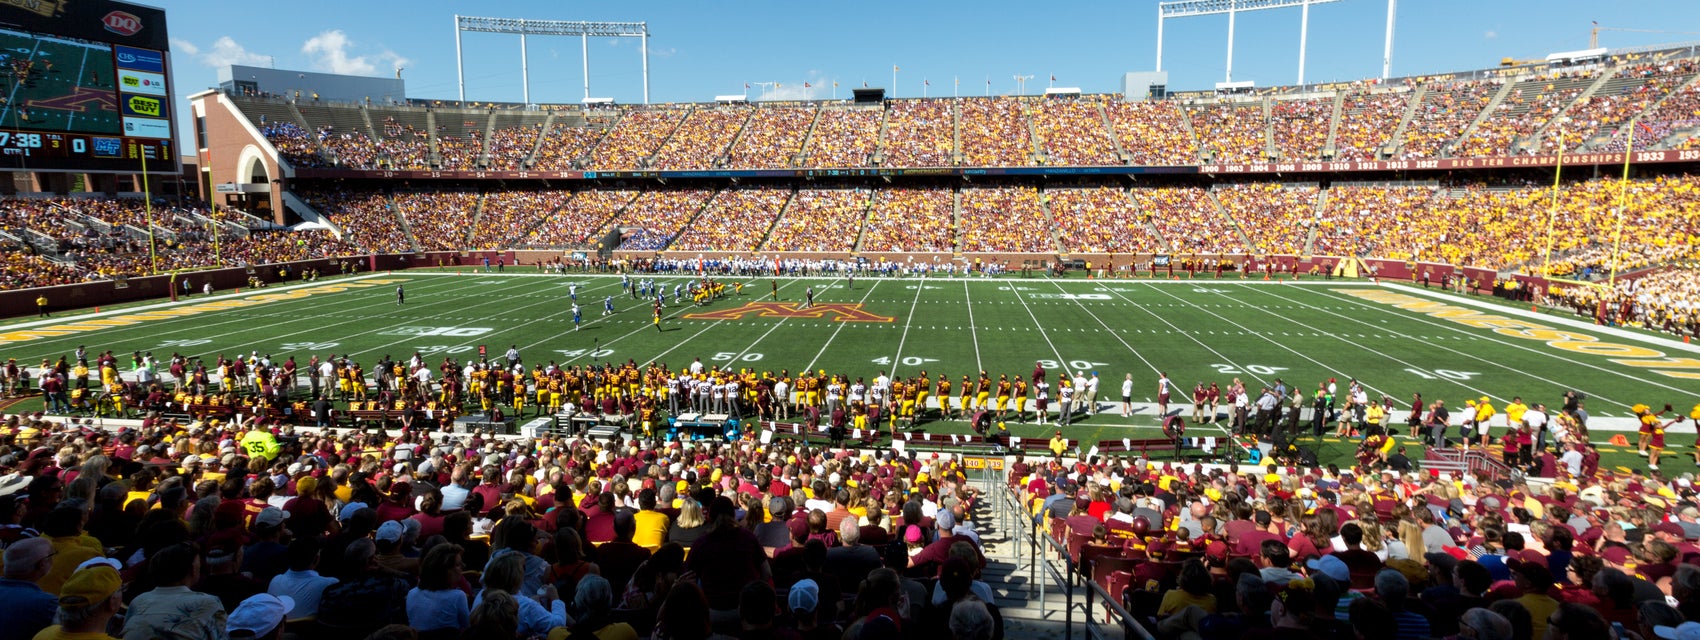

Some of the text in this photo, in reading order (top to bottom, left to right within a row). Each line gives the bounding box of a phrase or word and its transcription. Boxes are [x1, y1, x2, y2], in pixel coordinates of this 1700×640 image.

[110, 15, 137, 32] DQ
[133, 99, 159, 108] BEST
[134, 105, 157, 113] BUY
[0, 132, 42, 148] 7:38
[52, 140, 60, 148] 3
[73, 138, 87, 153] 0
[96, 140, 120, 155] MT
[25, 148, 31, 157] 1
[1637, 152, 1665, 162] 1933
[1386, 161, 1408, 169] 1915
[1416, 160, 1439, 168] 1927
[1452, 154, 1622, 167] BIG TEN CHAMPONSHIPS
[1201, 165, 1219, 173] 1900
[1249, 164, 1269, 172] 1904
[1275, 164, 1295, 172] 1906
[1302, 163, 1323, 171] 1909
[1328, 287, 1700, 379] MINNESOT
[710, 352, 765, 361] 50
[870, 356, 924, 366] 40
[1210, 364, 1276, 375] 20
[1403, 368, 1473, 380] 10
[248, 441, 265, 453] 35
